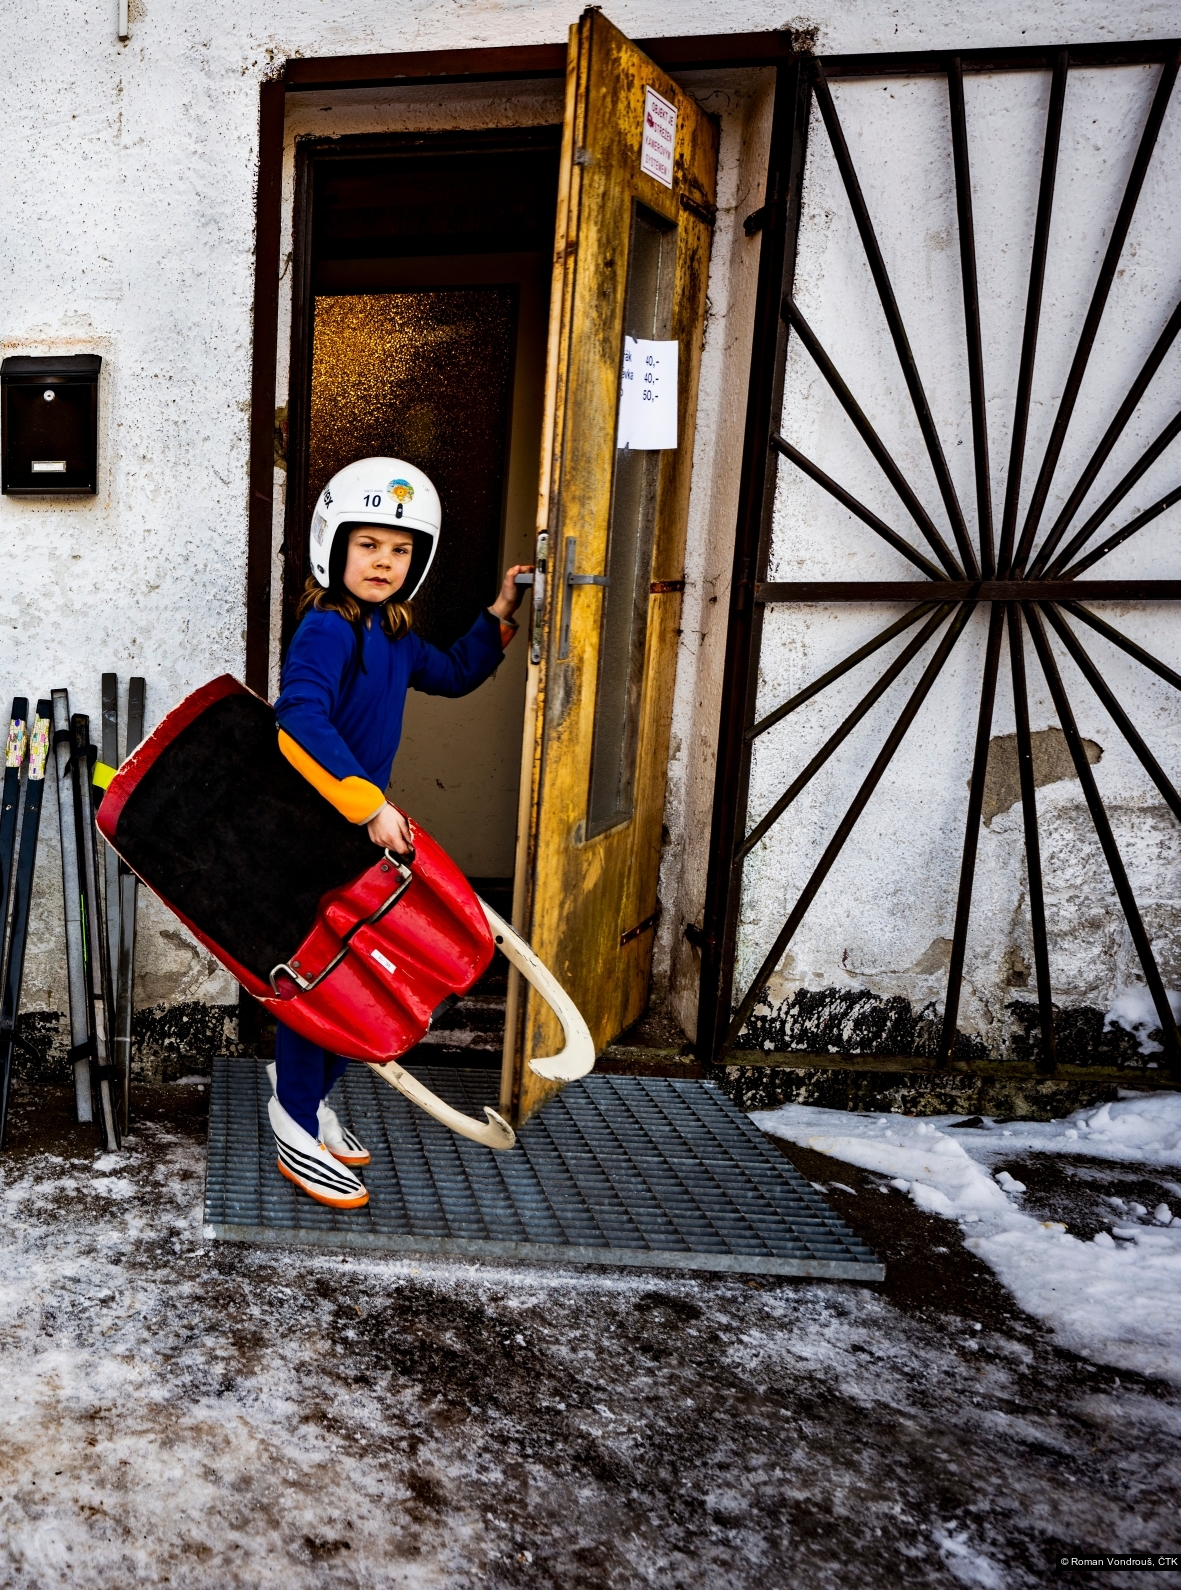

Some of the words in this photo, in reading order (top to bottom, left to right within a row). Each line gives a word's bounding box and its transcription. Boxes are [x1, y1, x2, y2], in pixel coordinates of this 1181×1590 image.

[651, 102, 669, 121] OBJEKT
[668, 115, 674, 127] JE
[645, 356, 659, 368] 40,-
[644, 372, 659, 385] 40,-
[642, 389, 659, 403] 50,-
[363, 494, 382, 508] 10
